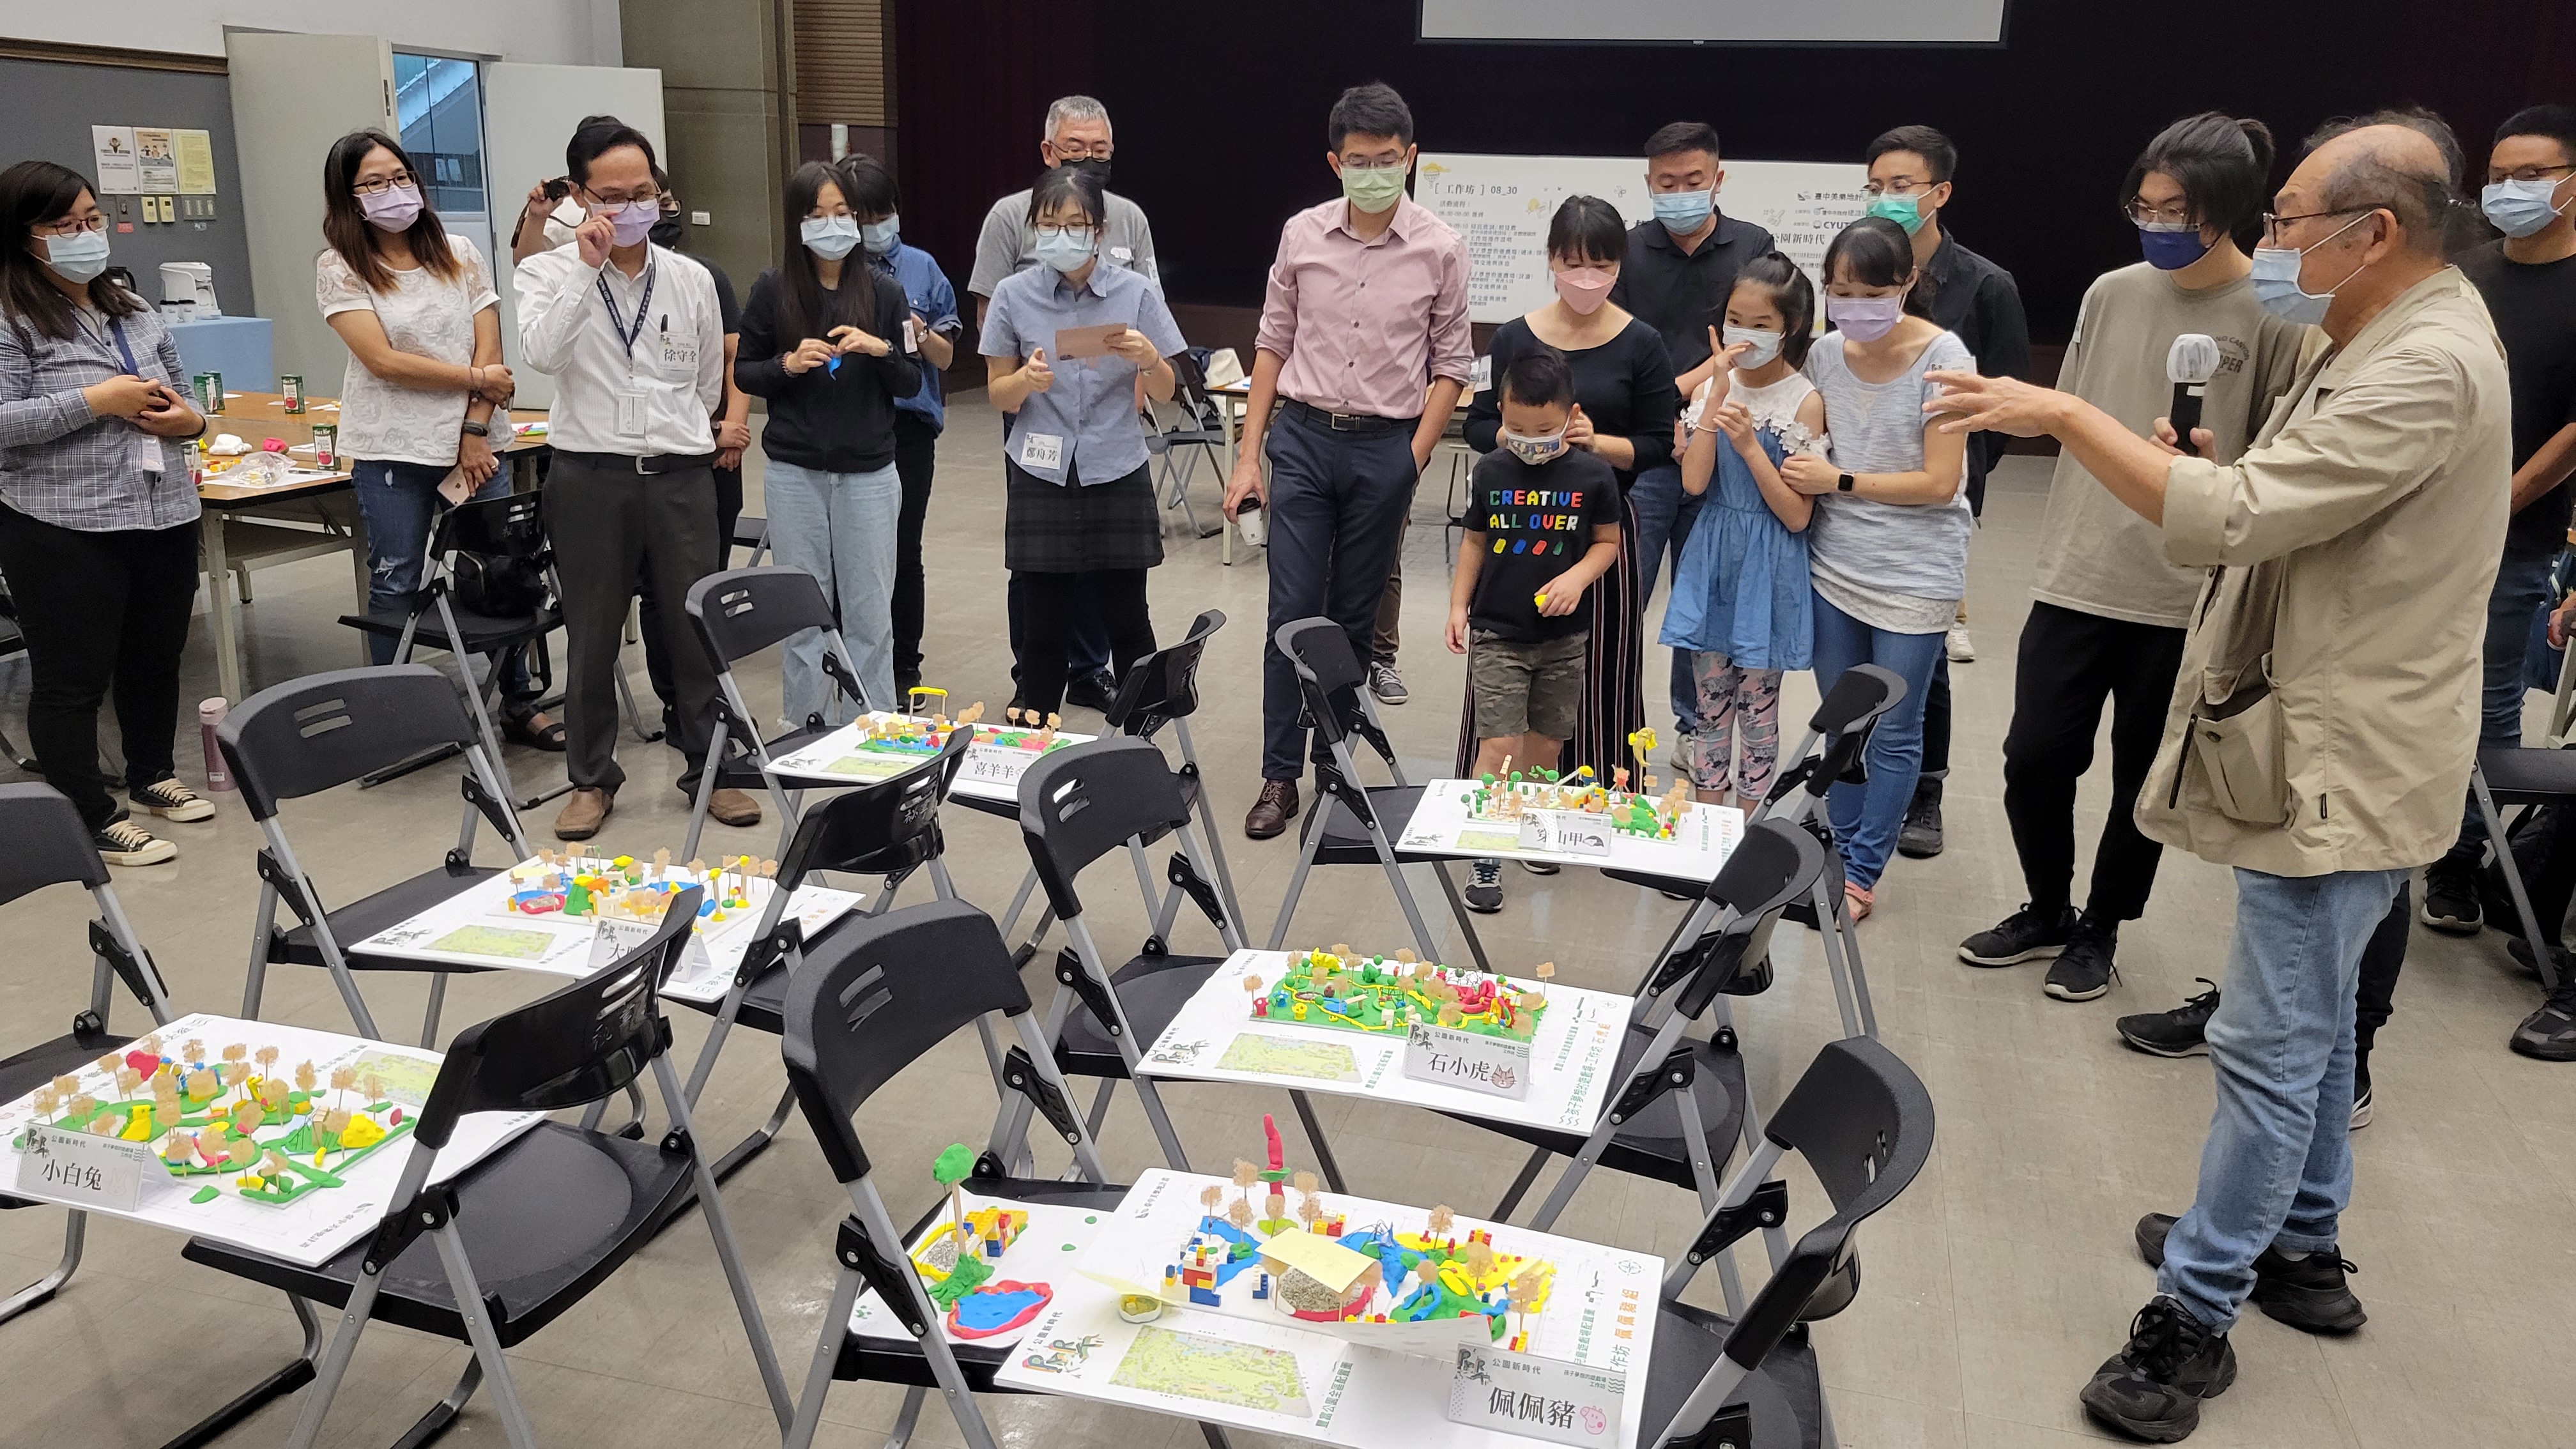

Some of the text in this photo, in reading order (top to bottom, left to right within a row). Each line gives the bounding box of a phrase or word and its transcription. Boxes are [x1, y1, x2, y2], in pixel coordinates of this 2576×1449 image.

[1445, 184, 1475, 195] 工作坊
[1491, 186, 1517, 195] 08_30
[1814, 192, 1862, 201] 臺中美樂地計
[1489, 490, 1583, 507] CREATIVE
[1489, 514, 1579, 530] ALL OVER
[975, 762, 1015, 779] 喜羊羊
[1434, 1031, 1469, 1044] 公園新時代
[1428, 1052, 1490, 1082] 石小虎
[51, 1135, 86, 1148] 公園新時代
[42, 1159, 102, 1191] 小白兔
[1032, 1311, 1063, 1346] 公園新時代
[1492, 1358, 1541, 1375] 公園新時代
[1564, 1369, 1606, 1383] 孩子夢想的遊戲場
[1589, 1381, 1606, 1390] 工作坊
[1489, 1386, 1575, 1429] 佩佩豬
